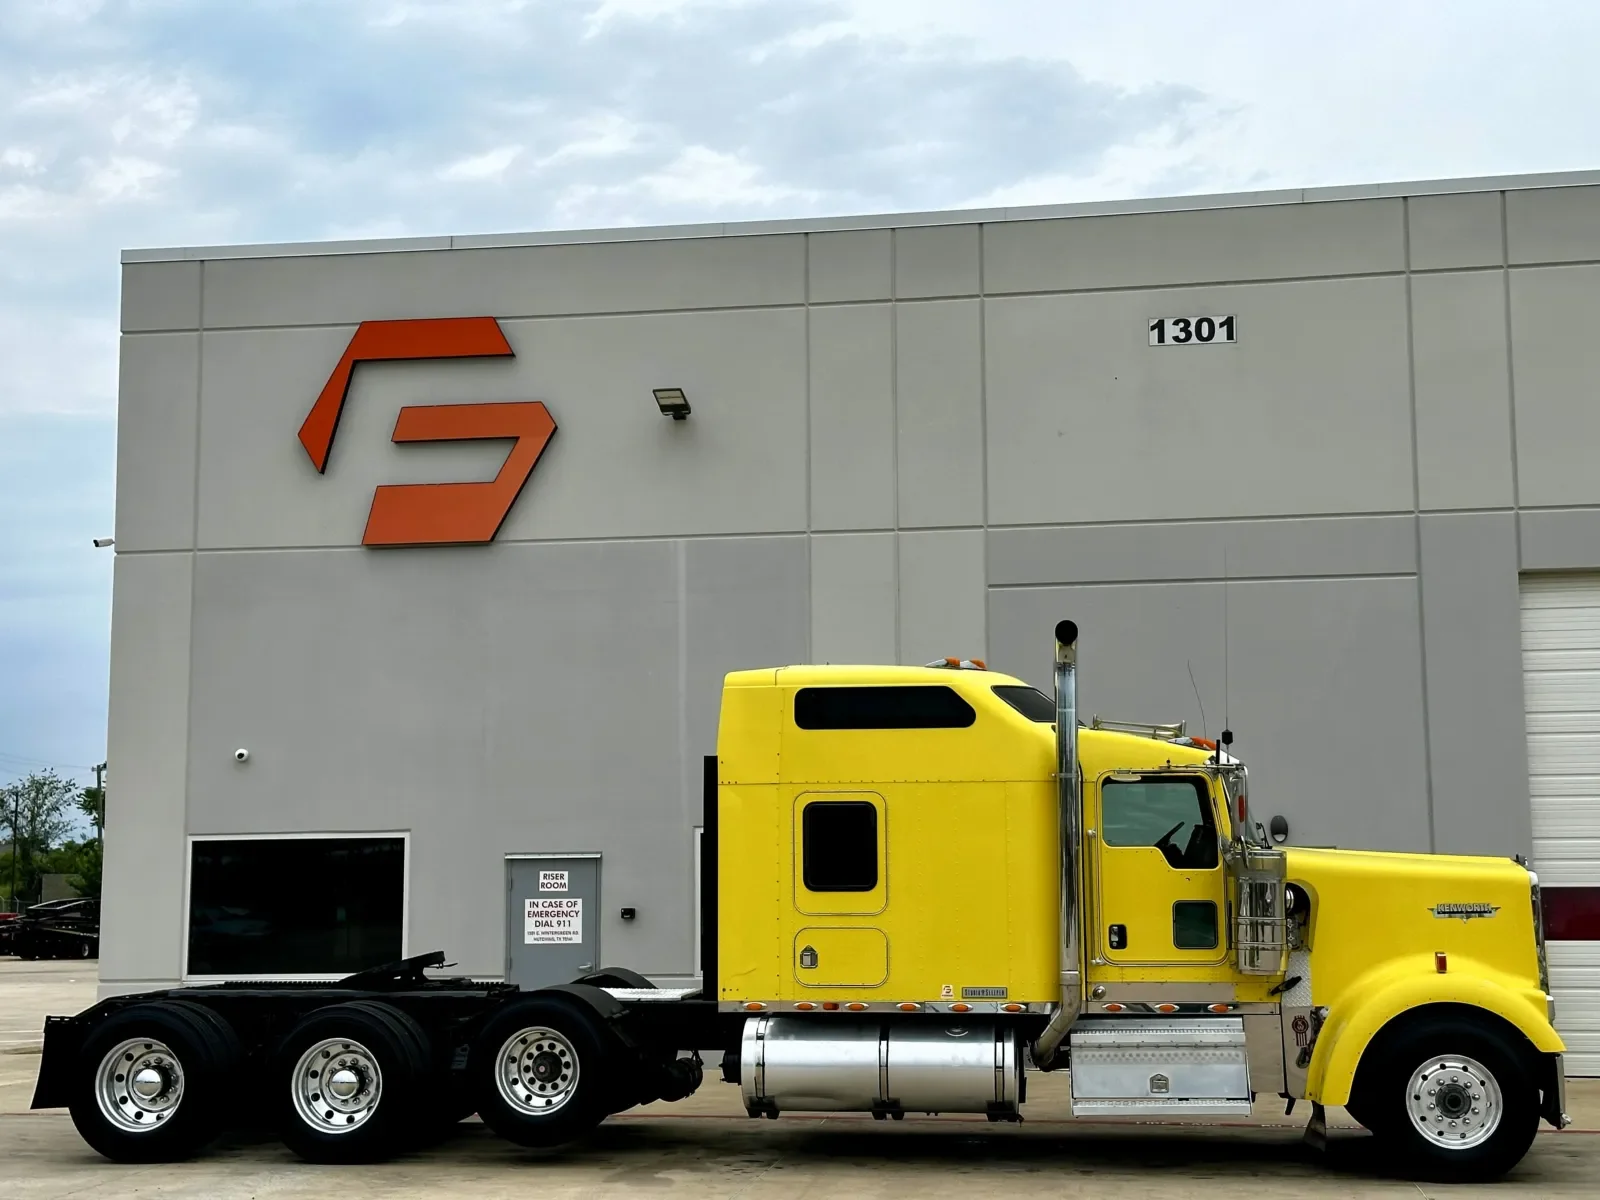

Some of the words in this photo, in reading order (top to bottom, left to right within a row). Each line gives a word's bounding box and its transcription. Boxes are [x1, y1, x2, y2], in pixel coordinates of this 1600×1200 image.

[1150, 316, 1234, 343] 1301
[541, 900, 564, 908] CASE
[565, 900, 578, 908] OF
[1437, 903, 1492, 912] KENWORTH
[527, 910, 580, 918] EMERGENCY
[534, 920, 554, 928] DIAL
